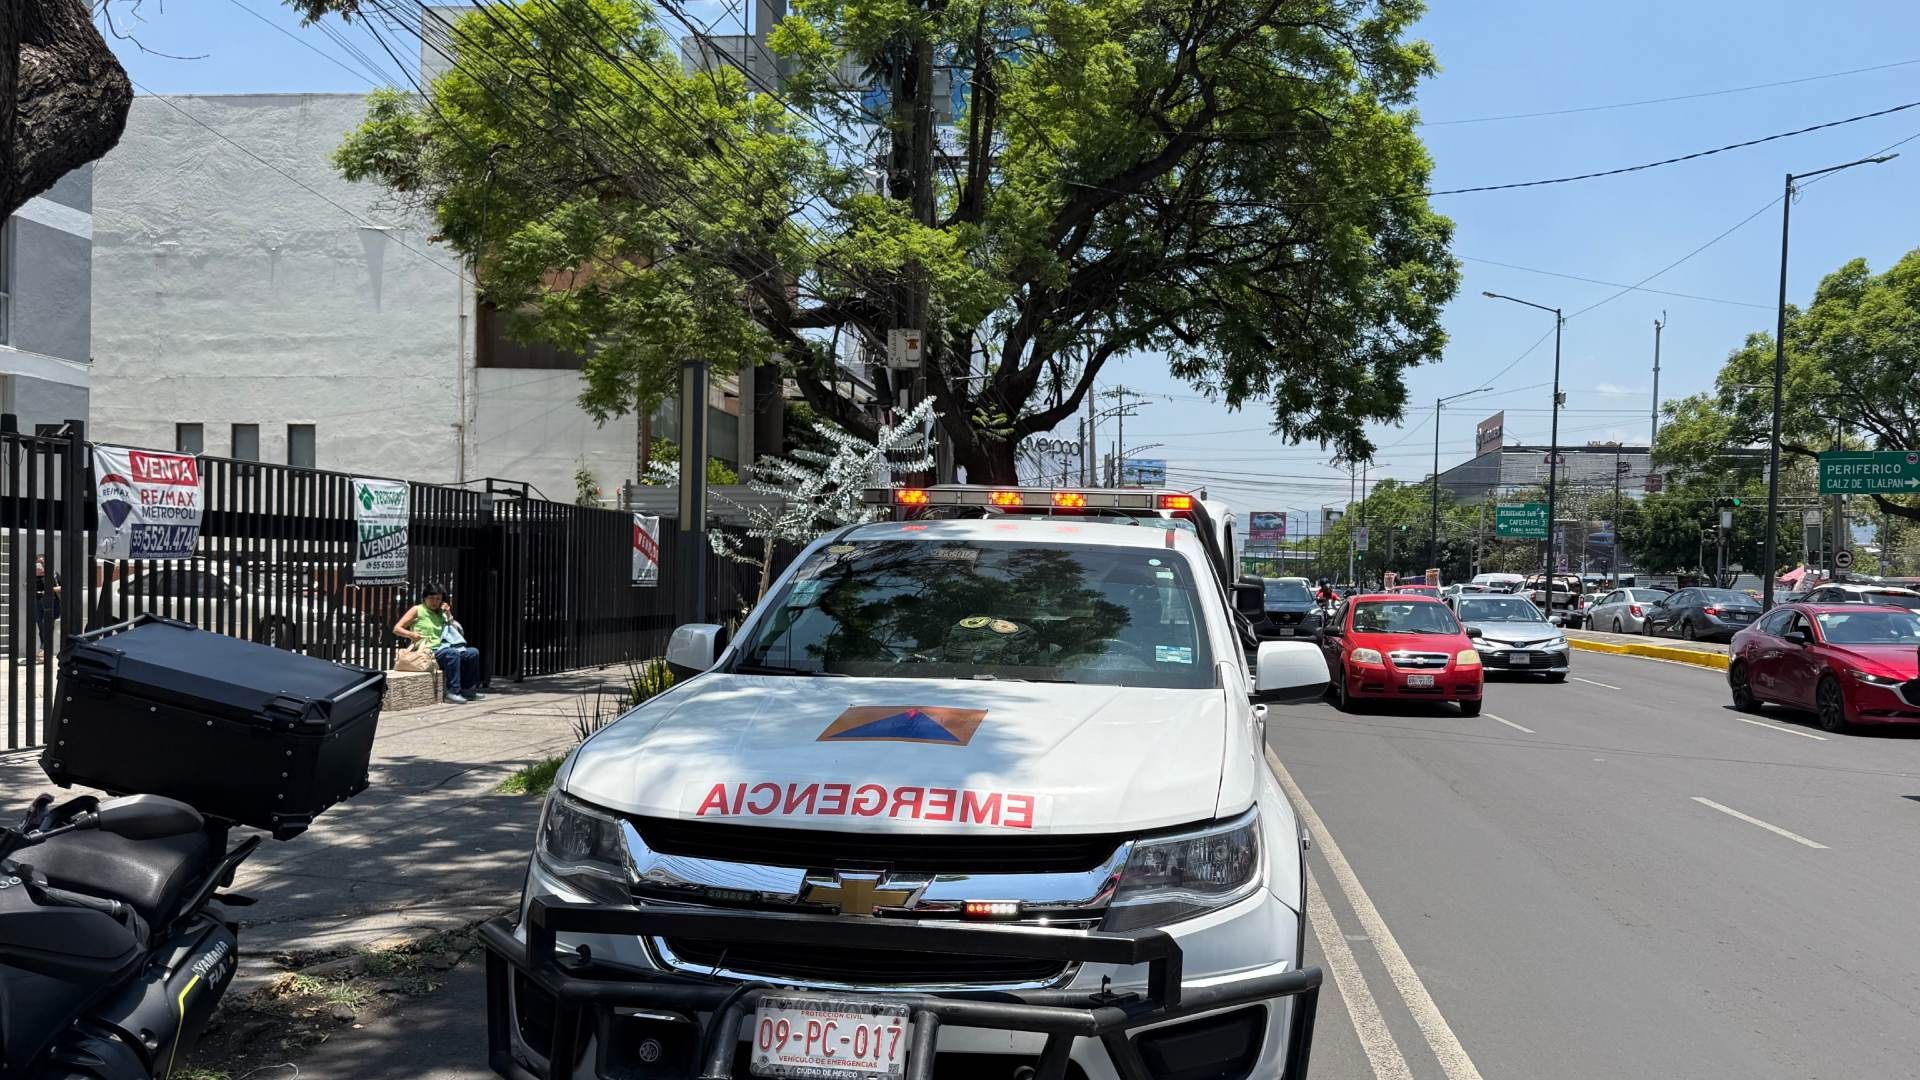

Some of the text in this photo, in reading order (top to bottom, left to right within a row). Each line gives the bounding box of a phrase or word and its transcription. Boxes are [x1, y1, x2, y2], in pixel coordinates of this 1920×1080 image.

[1025, 437, 1080, 458] verpoo
[136, 455, 193, 482] VENTA
[1827, 464, 1902, 475] PERIFERICO
[1827, 478, 1904, 489] CALZ DE TLALPAN
[102, 486, 129, 499] RE/MAX
[140, 489, 195, 508] RE/MAX
[362, 531, 408, 558] VENDIDO
[195, 940, 229, 974] YAMAHA
[846, 1012, 864, 1020] CIVIL
[759, 1017, 902, 1062] 09-PC-017
[796, 1066, 821, 1075] CIUDAD
[815, 1057, 826, 1065] DE
[827, 1058, 878, 1069] EMERGENCIAS
